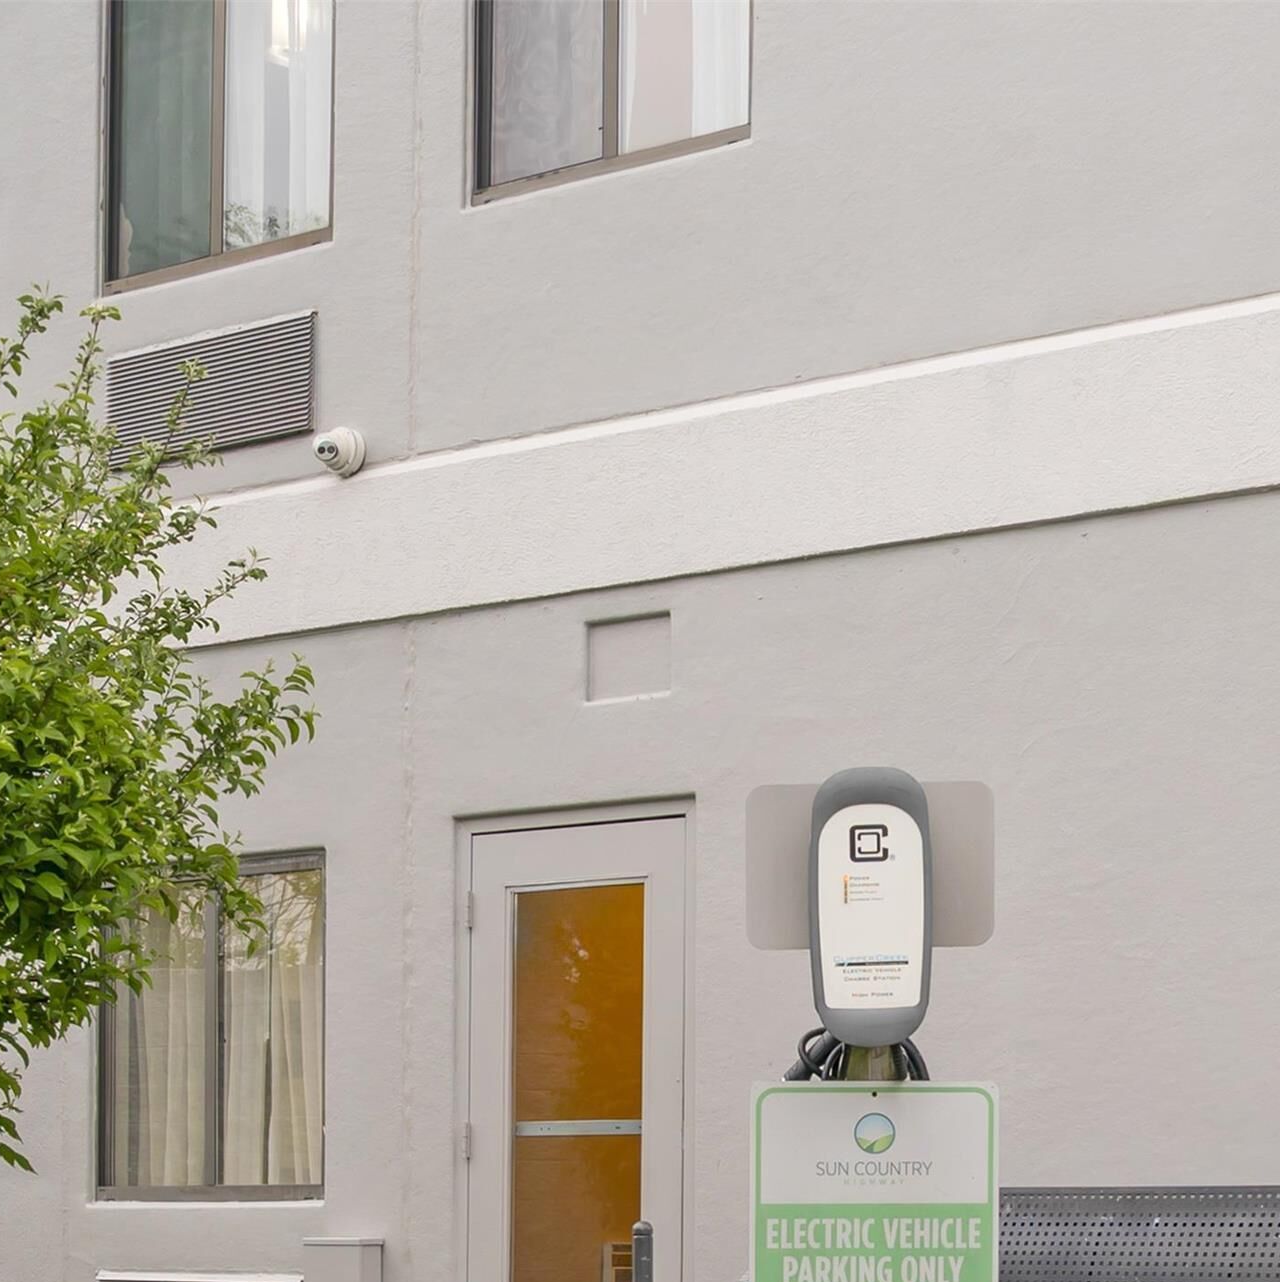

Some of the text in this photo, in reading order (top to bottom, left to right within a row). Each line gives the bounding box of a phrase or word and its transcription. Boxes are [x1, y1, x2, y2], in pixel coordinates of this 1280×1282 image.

[816, 1161, 933, 1176] SUN COUNTRY
[766, 1218, 982, 1249] ELECTRIC VEHICLE
